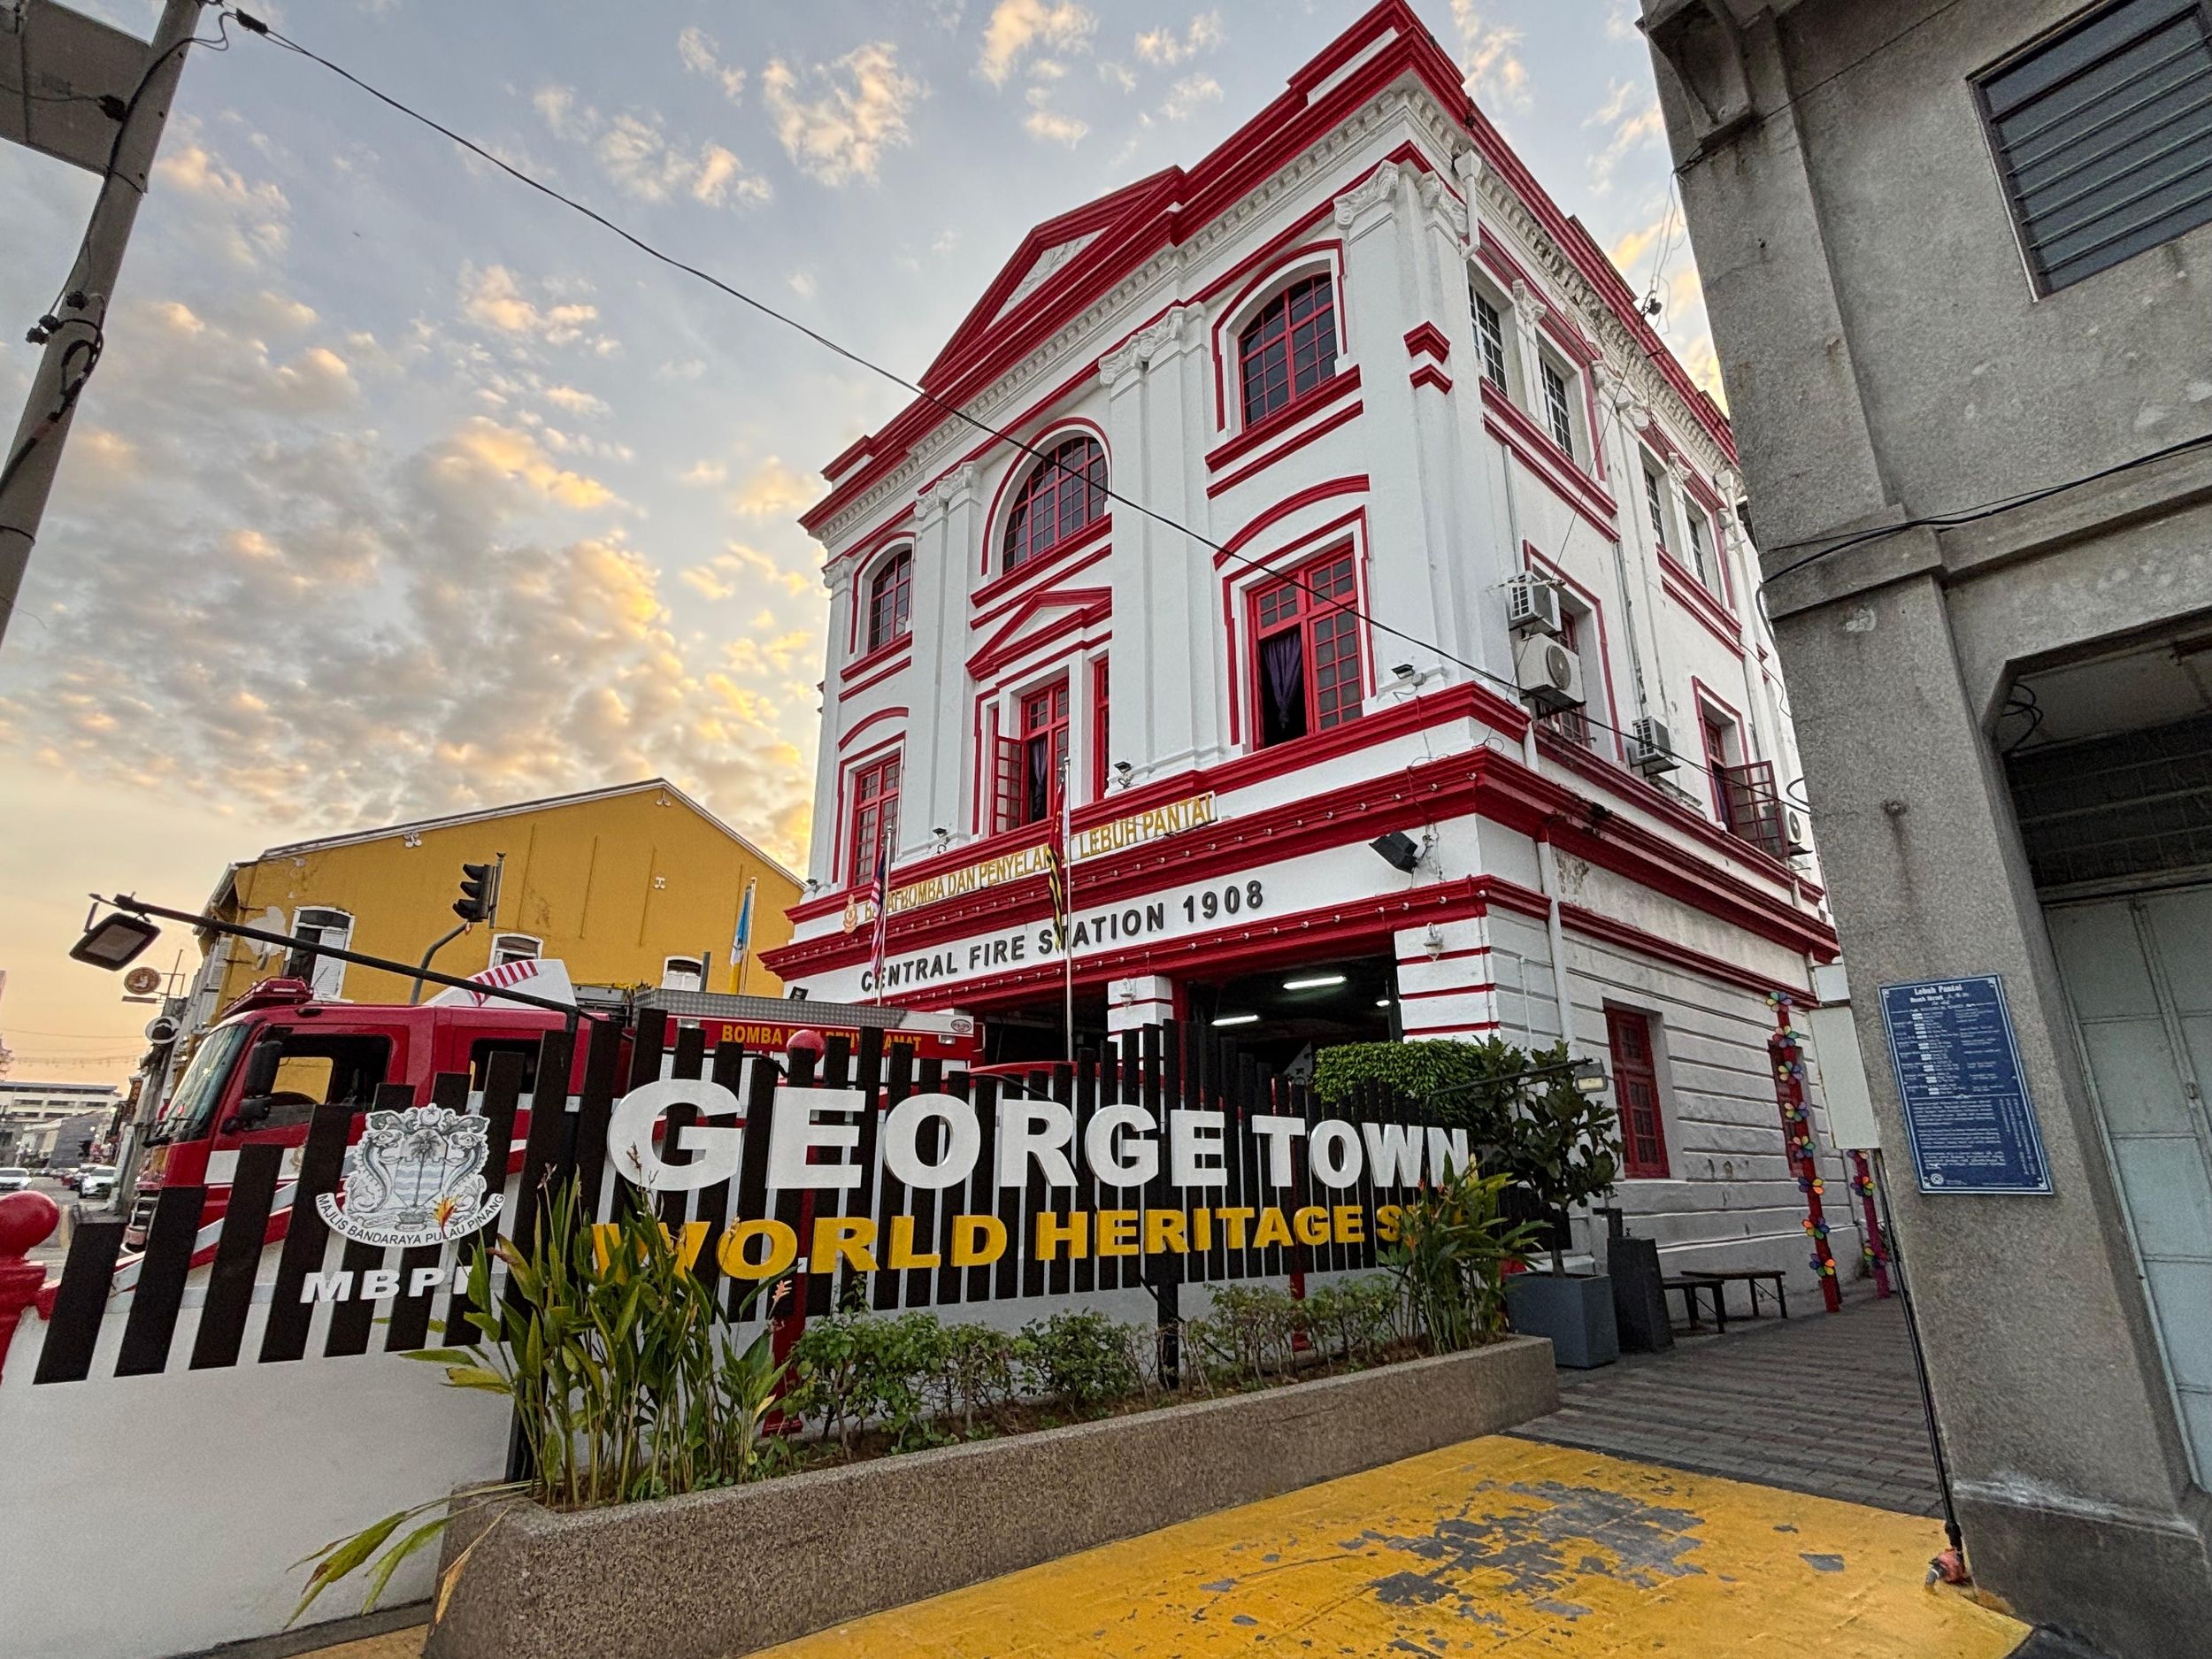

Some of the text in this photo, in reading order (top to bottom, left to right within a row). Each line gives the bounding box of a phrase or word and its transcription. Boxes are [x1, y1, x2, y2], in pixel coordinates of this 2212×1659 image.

[864, 793, 1211, 920] BAI BOMBA DAN PENYELA LEBUH PANTAI
[969, 934, 1025, 970] FIRE
[1182, 879, 1263, 923] 1908
[721, 1025, 783, 1045] BOMBA
[607, 1079, 1470, 1191] GEORGE TOWN
[318, 1194, 349, 1230] MAJLIS
[347, 1222, 422, 1245] BANDARAYA
[468, 1194, 505, 1230] PINANG
[1035, 1204, 1365, 1261] HERITAGE
